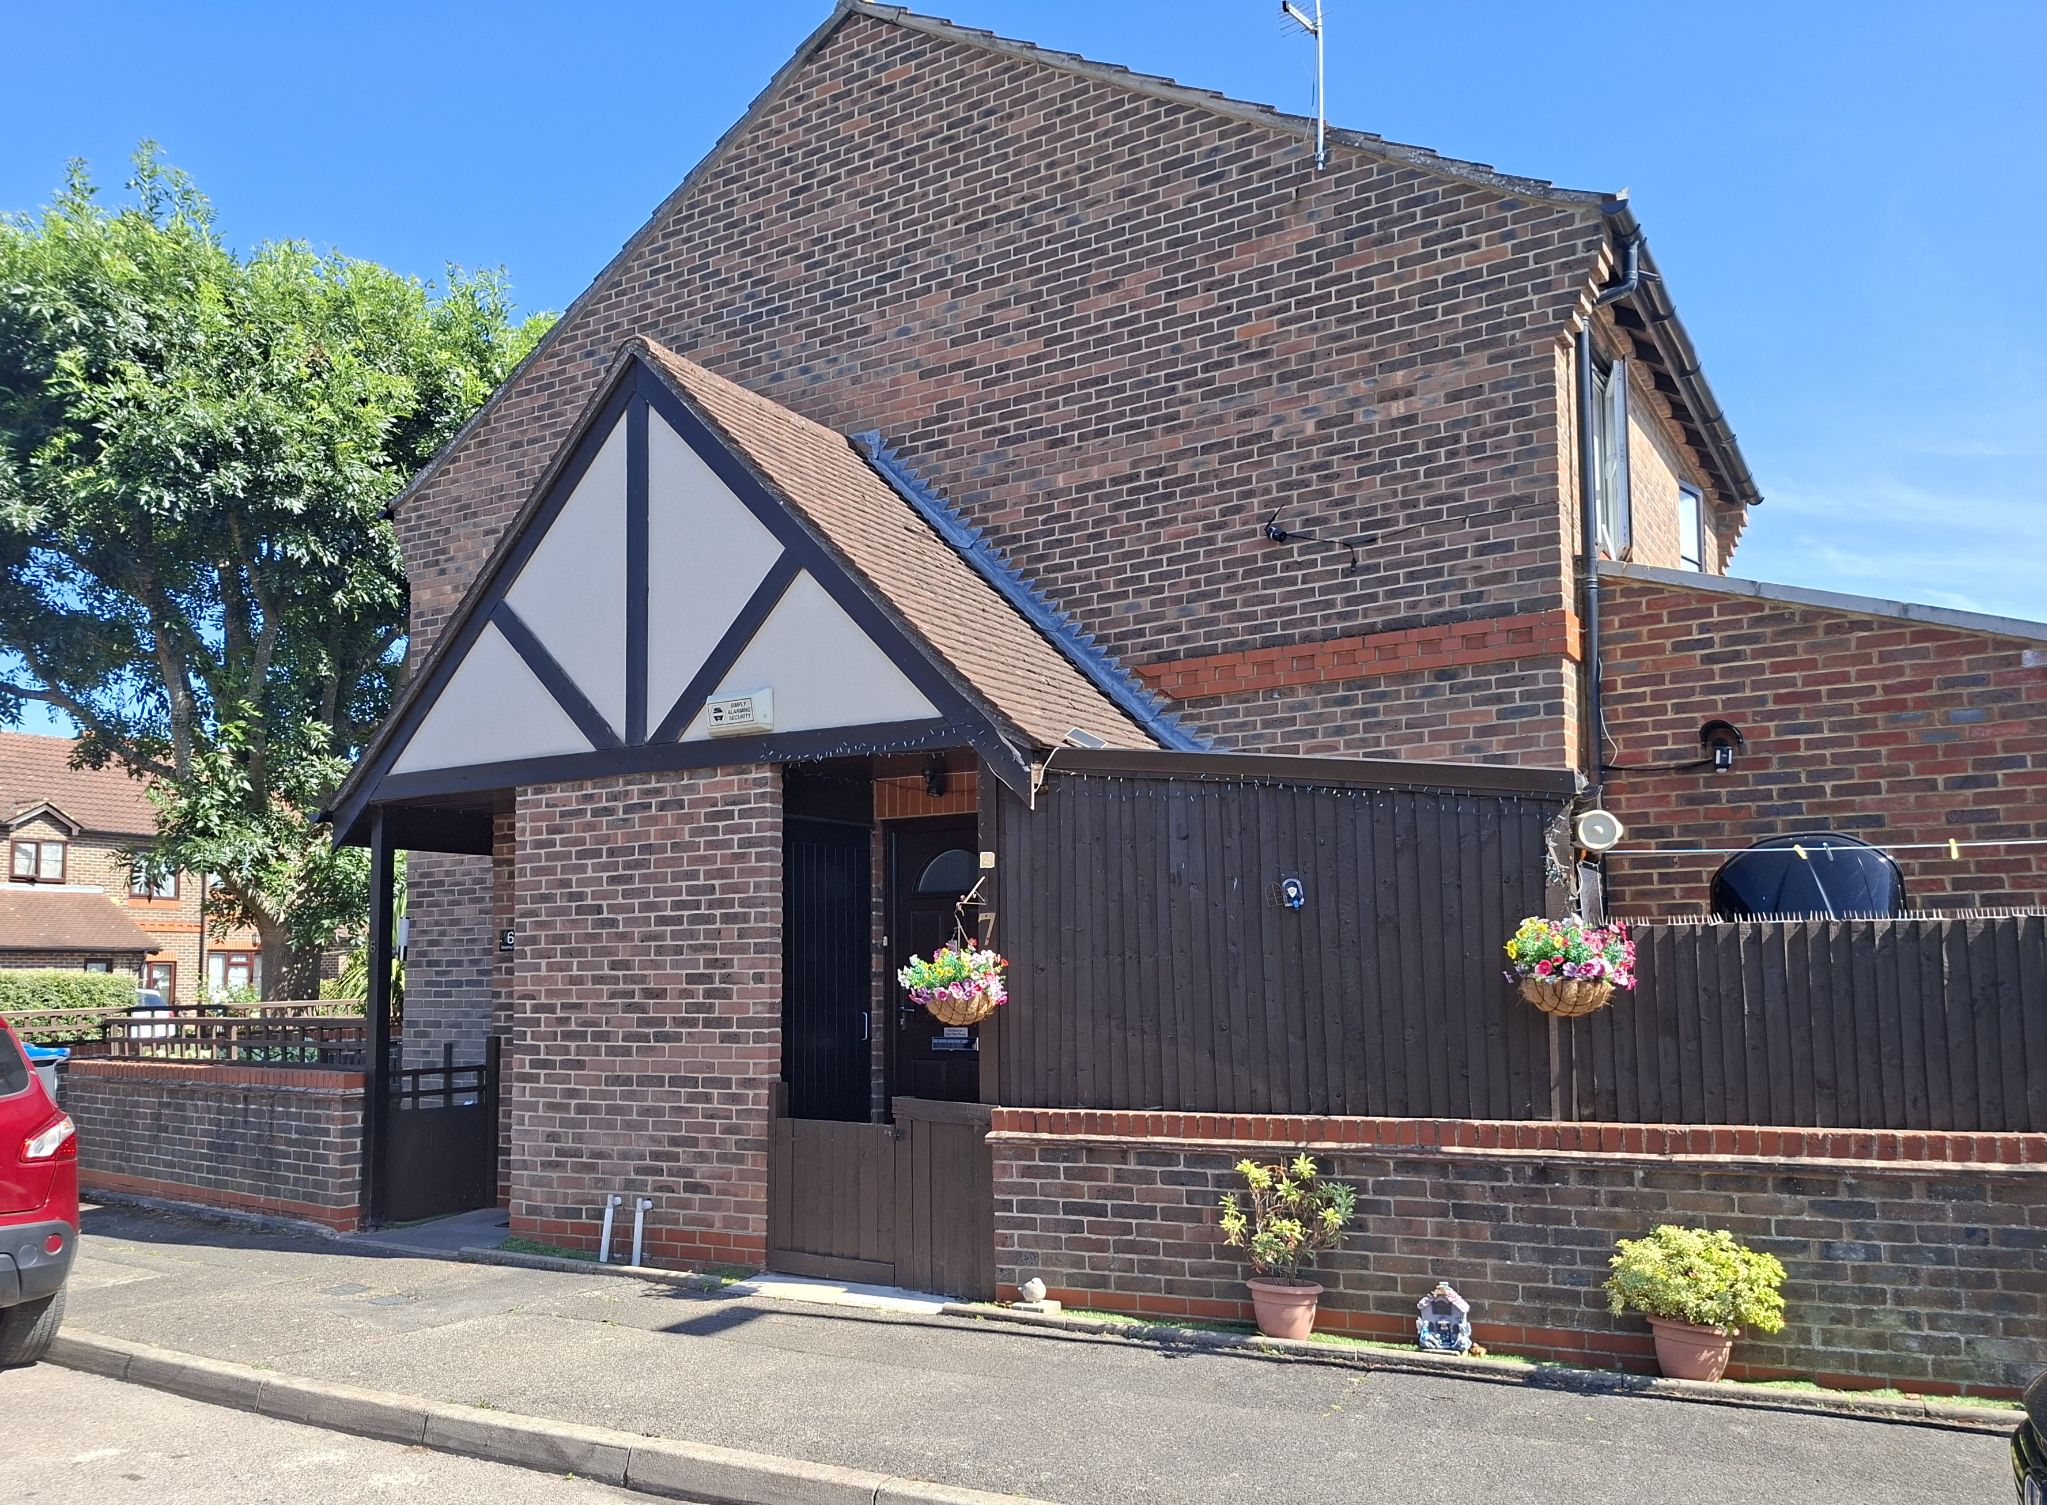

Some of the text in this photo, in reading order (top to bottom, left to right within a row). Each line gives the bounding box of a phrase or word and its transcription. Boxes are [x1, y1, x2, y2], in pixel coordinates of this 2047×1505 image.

[728, 706, 751, 714] ALARMING
[978, 912, 996, 945] 7
[507, 931, 515, 944] 6
[370, 940, 376, 953] 6
